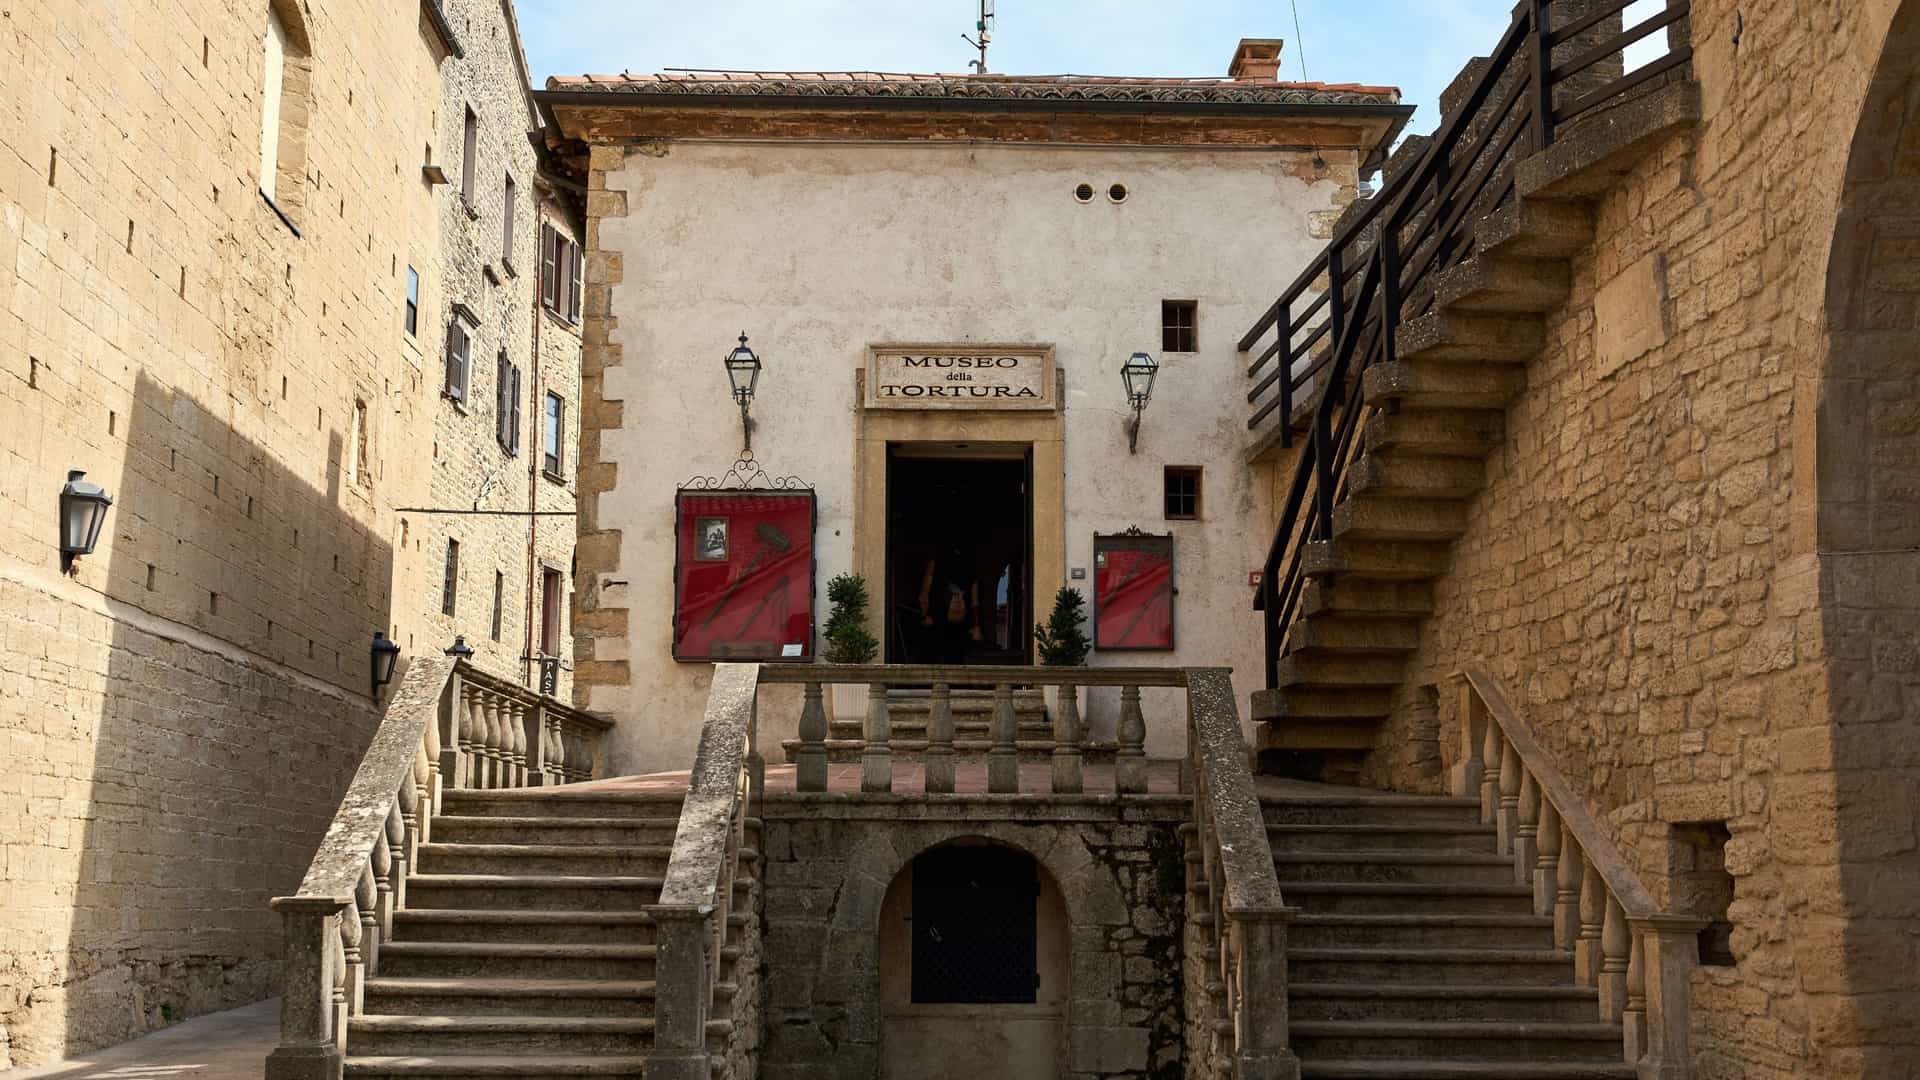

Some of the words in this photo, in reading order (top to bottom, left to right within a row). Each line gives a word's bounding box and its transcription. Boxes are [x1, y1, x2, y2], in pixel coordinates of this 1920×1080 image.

[902, 356, 1018, 368] MUSEO
[946, 372, 972, 381] della
[881, 385, 1038, 397] TORTURA
